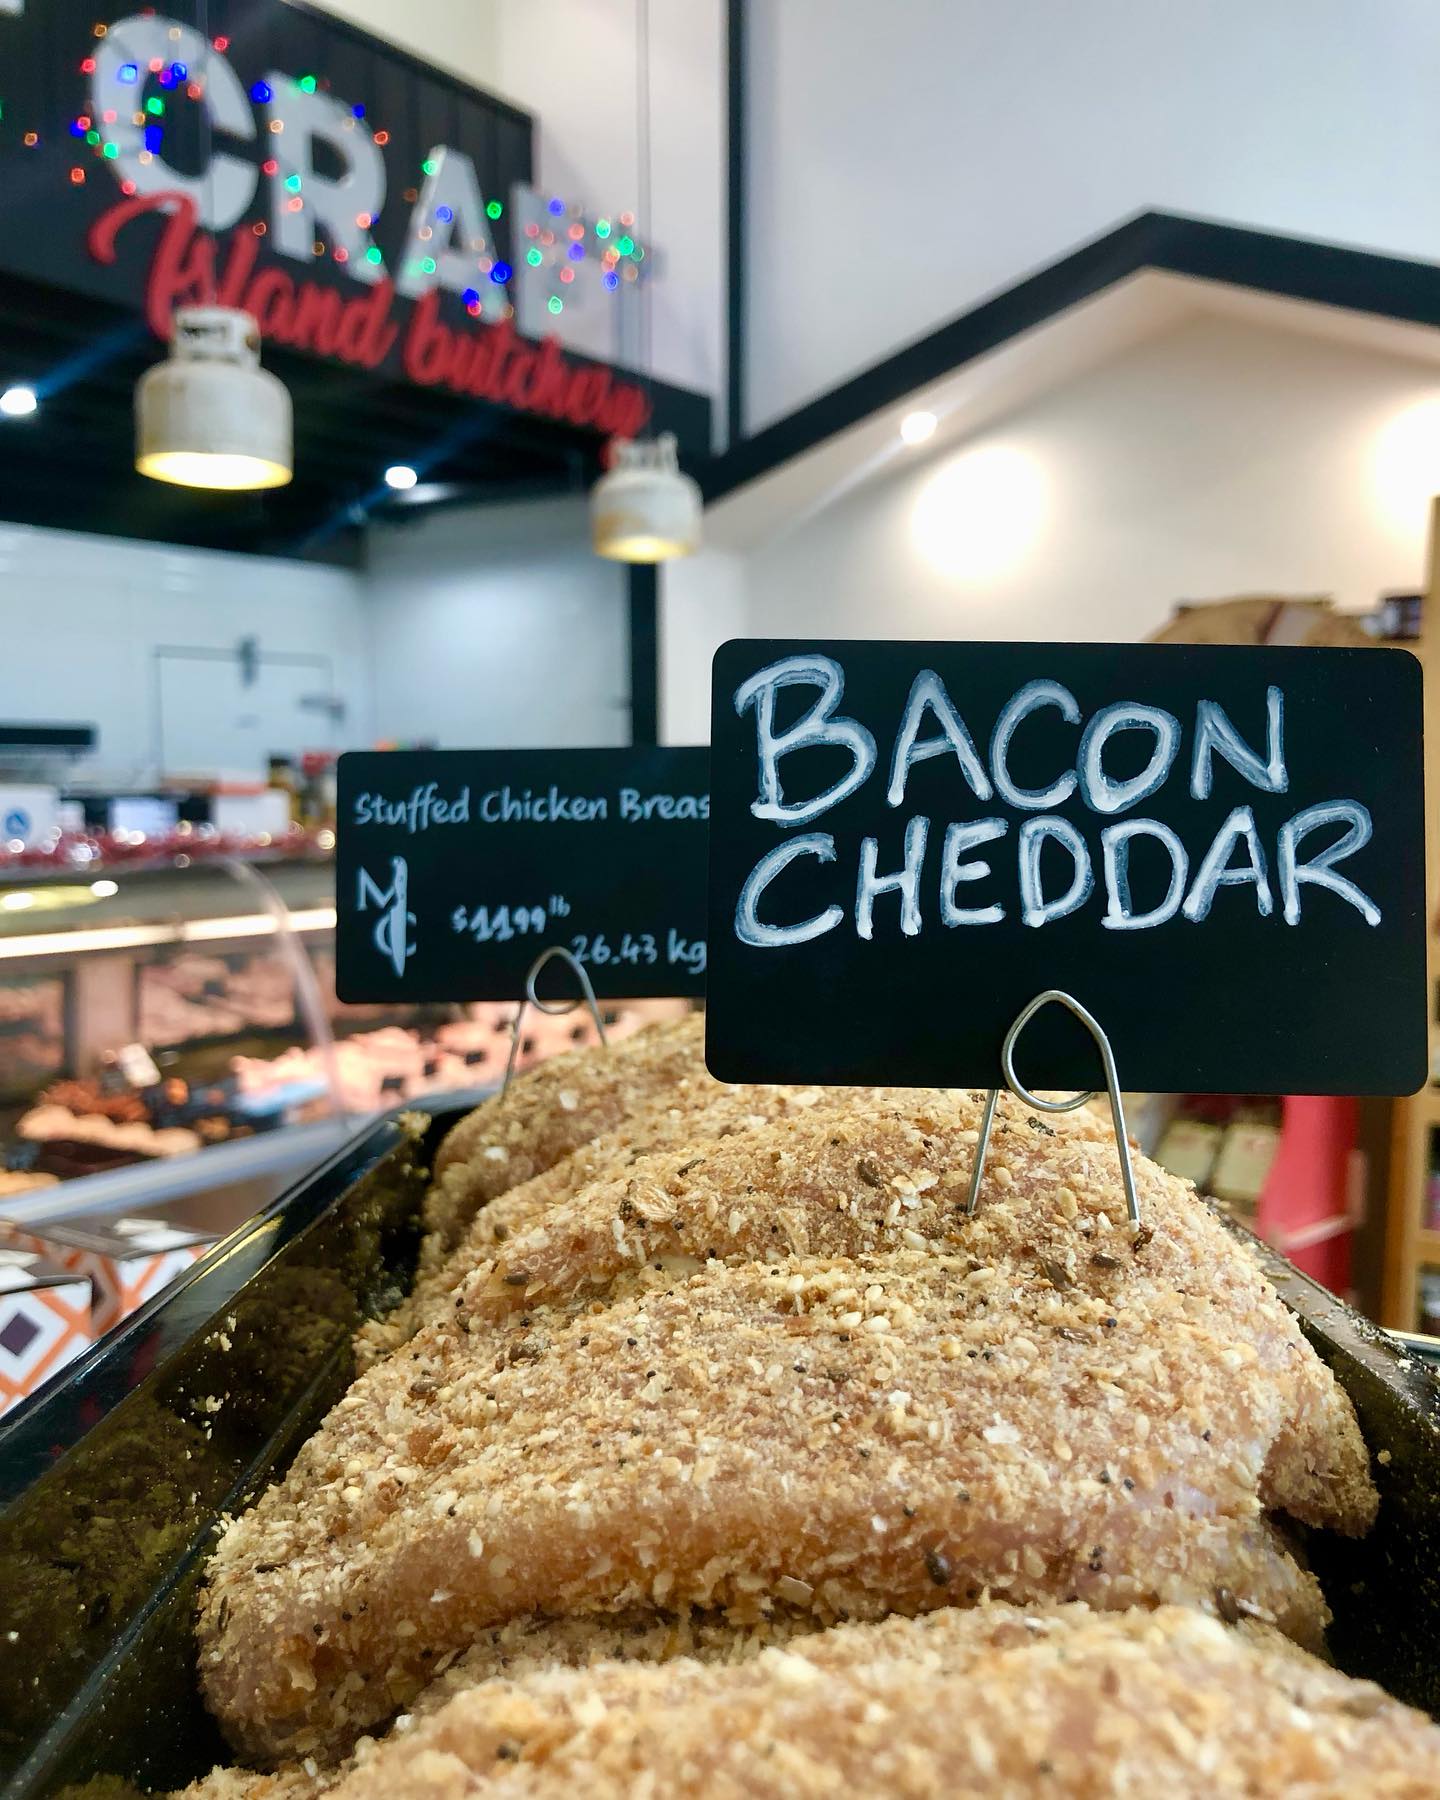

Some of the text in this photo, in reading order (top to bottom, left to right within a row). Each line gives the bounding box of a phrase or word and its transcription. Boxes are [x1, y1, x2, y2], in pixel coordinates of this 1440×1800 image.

[735, 654, 1289, 828] BACON
[354, 782, 469, 834] Stuffed
[480, 786, 607, 822] Chicken
[734, 798, 1382, 947] CHEDDAR
[570, 928, 708, 974] 26.43 kg
